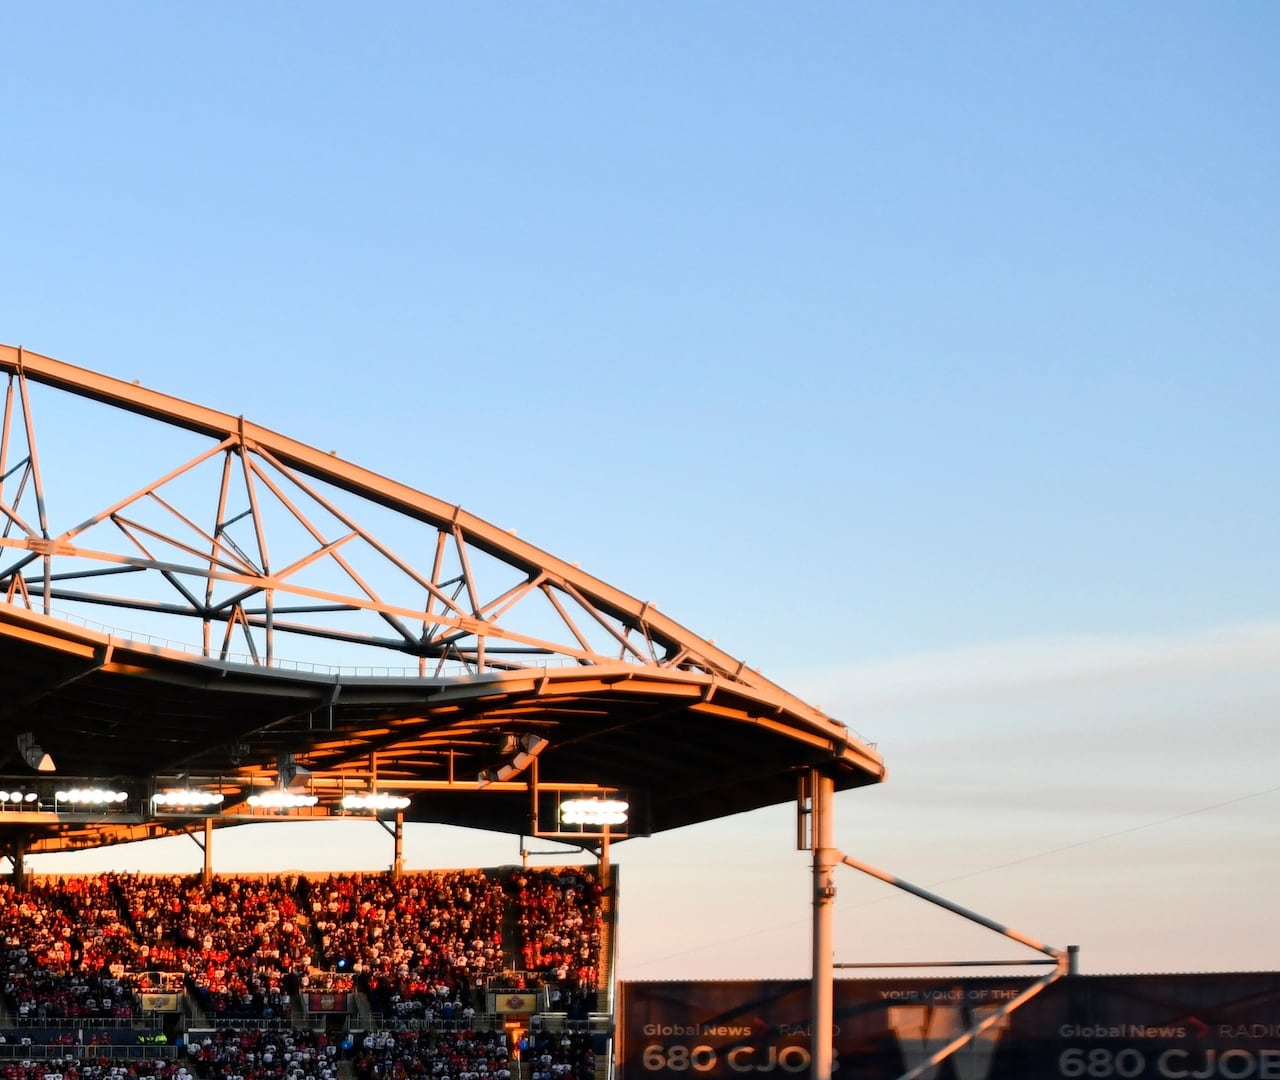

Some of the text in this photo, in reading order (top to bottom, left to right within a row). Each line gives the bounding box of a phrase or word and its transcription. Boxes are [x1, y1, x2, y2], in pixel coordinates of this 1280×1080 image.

[881, 991, 919, 1001] YOUR
[969, 991, 986, 1001] OF
[991, 990, 1019, 1001] THE
[643, 1023, 752, 1037] Global News
[1059, 1023, 1127, 1039] Global
[1132, 1023, 1187, 1039] News
[643, 1045, 718, 1072] 680
[1059, 1048, 1146, 1079] 680
